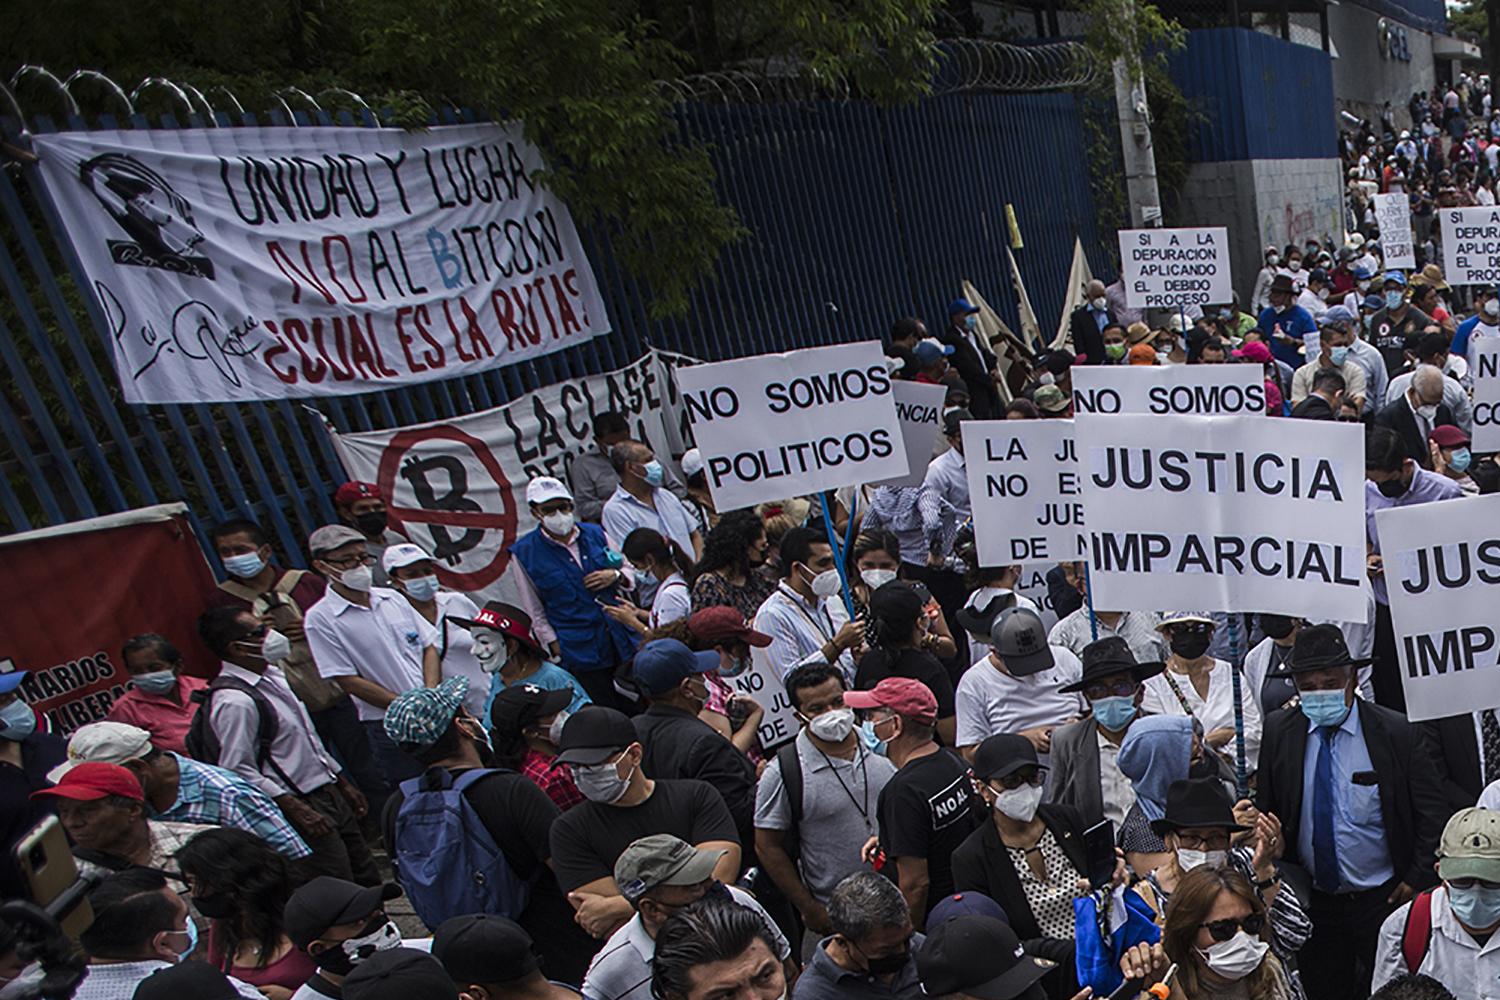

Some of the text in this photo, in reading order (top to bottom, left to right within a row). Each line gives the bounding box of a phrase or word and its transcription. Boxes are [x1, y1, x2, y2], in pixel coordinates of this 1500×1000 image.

[220, 142, 535, 226] UNIDAD Y LUCHA
[1450, 211, 1463, 224] SI
[1490, 211, 1500, 222] A
[1138, 233, 1215, 246] SI A LA
[1132, 248, 1217, 261] DEPURACION
[1456, 256, 1472, 269] EL
[266, 235, 366, 304] NO
[367, 231, 428, 301] AL
[1140, 264, 1217, 277] APLICANDO
[1134, 280, 1211, 293] EL DEBIDO
[1145, 292, 1210, 306] PROCESO
[395, 305, 446, 374] ES
[442, 296, 495, 364] LA
[683, 366, 891, 424] NO SOMOS
[1074, 385, 1265, 414] NO SOMOS
[503, 393, 566, 464] LA
[707, 429, 893, 489] POLITICOS
[985, 438, 1028, 462] LA
[986, 474, 1029, 497] NO
[1091, 447, 1344, 501] JUSTICIA
[1010, 538, 1049, 561] DE
[1091, 532, 1360, 586] IMPARCIAL
[737, 673, 765, 695] NO
[761, 719, 788, 742] DE
[935, 798, 957, 820] NO
